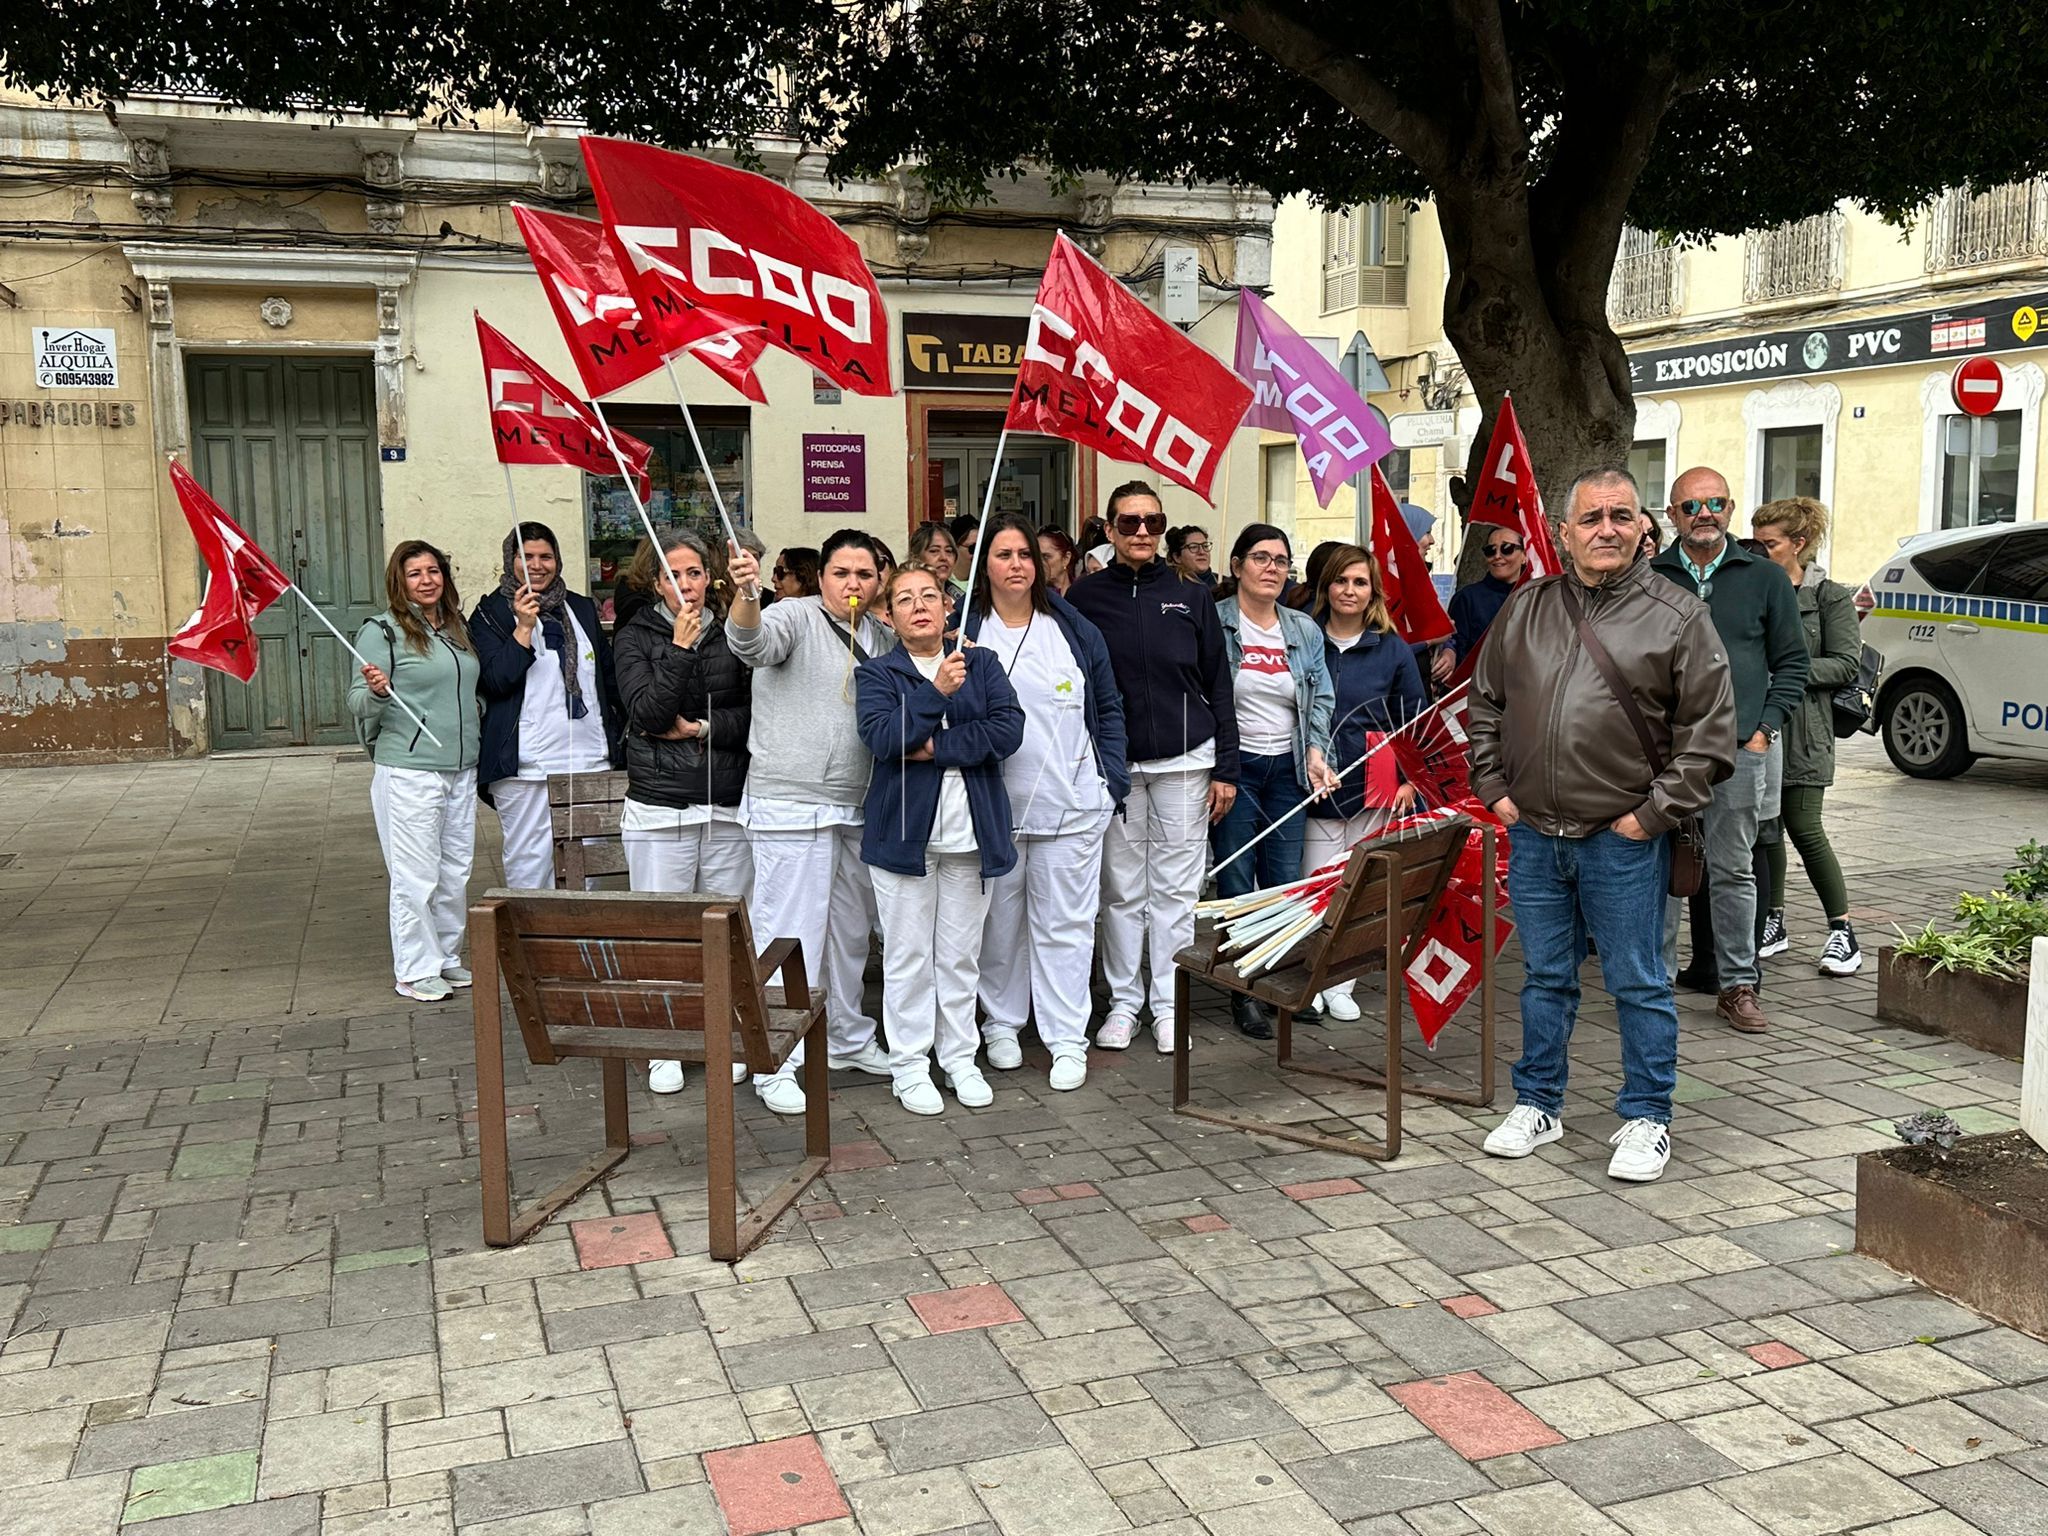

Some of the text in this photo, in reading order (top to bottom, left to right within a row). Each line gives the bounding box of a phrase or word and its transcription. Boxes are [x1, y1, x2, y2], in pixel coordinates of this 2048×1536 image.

[42, 331, 106, 354] Inver Hogar
[1656, 341, 1788, 381] EXPOSICIÓN
[1848, 328, 1901, 358] PVC
[39, 355, 114, 371] ALQUILA
[55, 373, 115, 385] 609543982
[811, 444, 861, 453] FOTOCOPIAS
[390, 450, 397, 460] 9
[811, 460, 845, 468] PRENSA
[812, 476, 851, 485] REVISTAS
[812, 492, 849, 500] REGALOS
[1915, 625, 1936, 637] 112
[2002, 701, 2048, 731] PO
